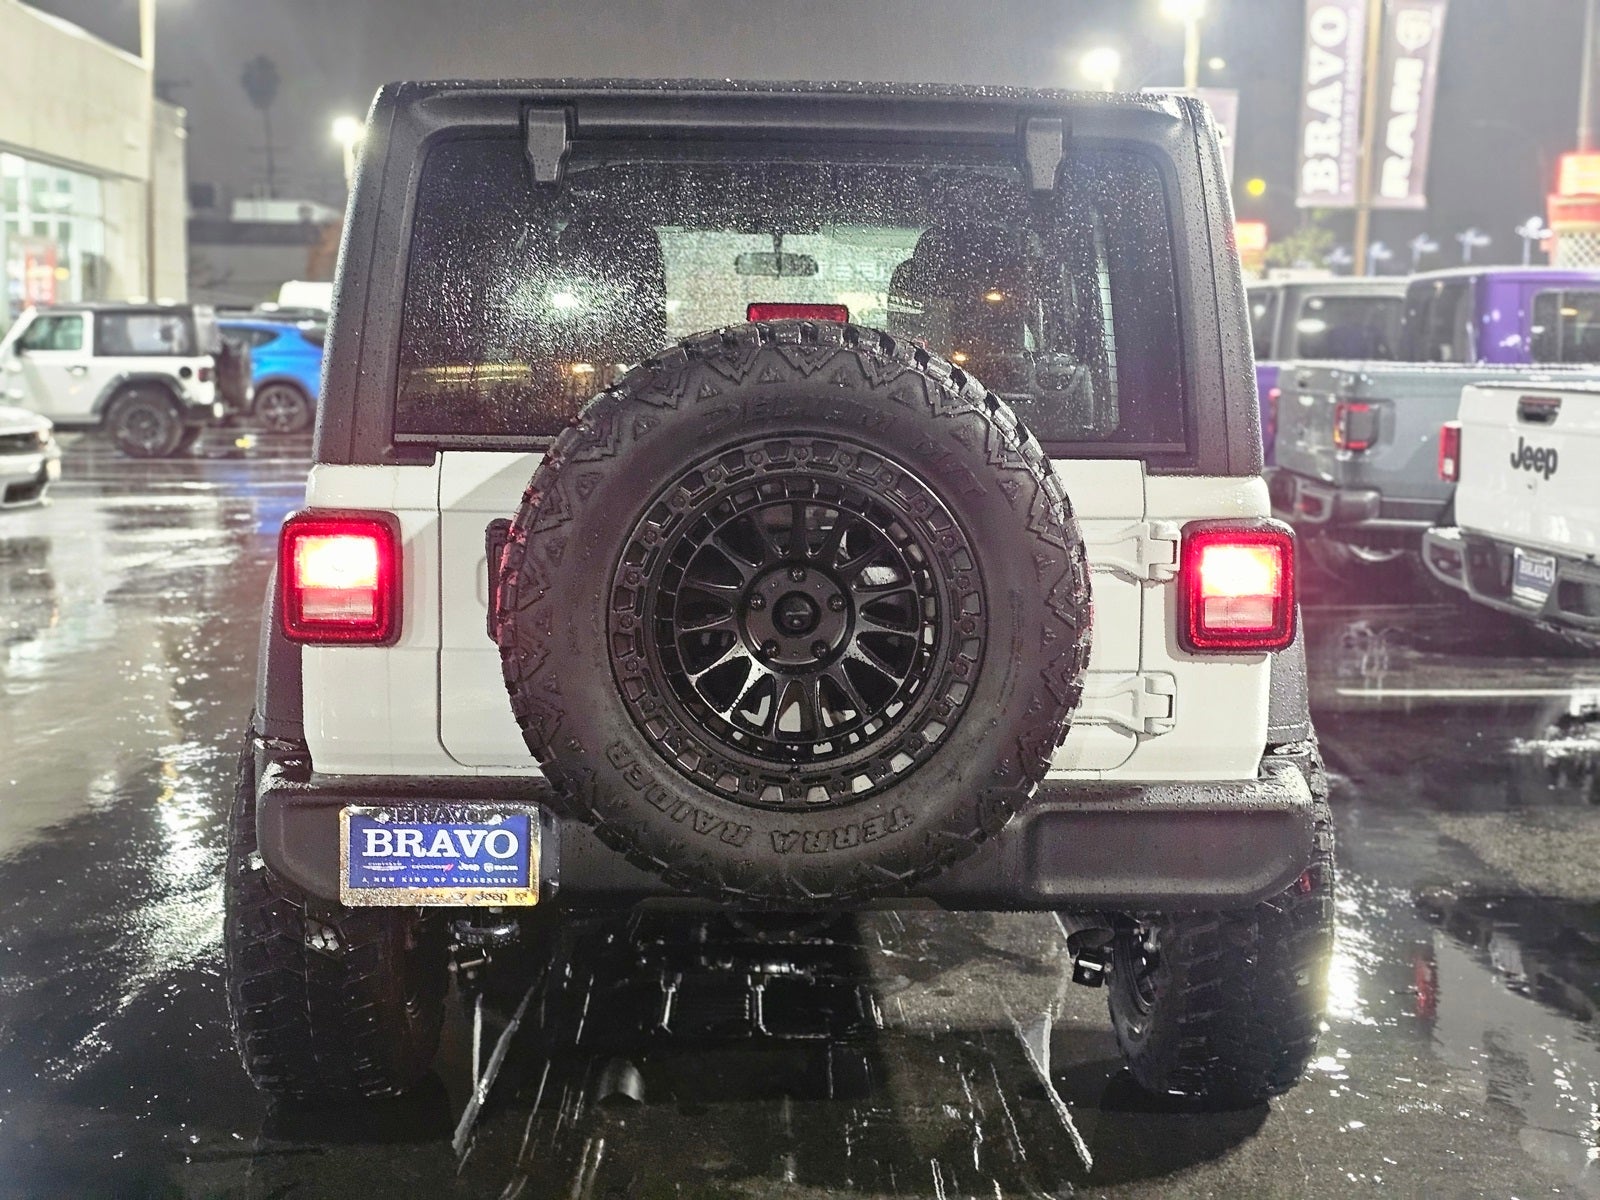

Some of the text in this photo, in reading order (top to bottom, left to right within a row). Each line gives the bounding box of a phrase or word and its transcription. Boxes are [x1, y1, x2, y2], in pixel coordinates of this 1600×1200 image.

[1302, 5, 1348, 195] BRAVO
[1380, 57, 1424, 198] RAM
[1510, 436, 1558, 480] Jeep
[606, 741, 915, 854] TERRA RAIDER
[362, 828, 519, 859] BRAVO
[475, 890, 508, 902] Jeep
